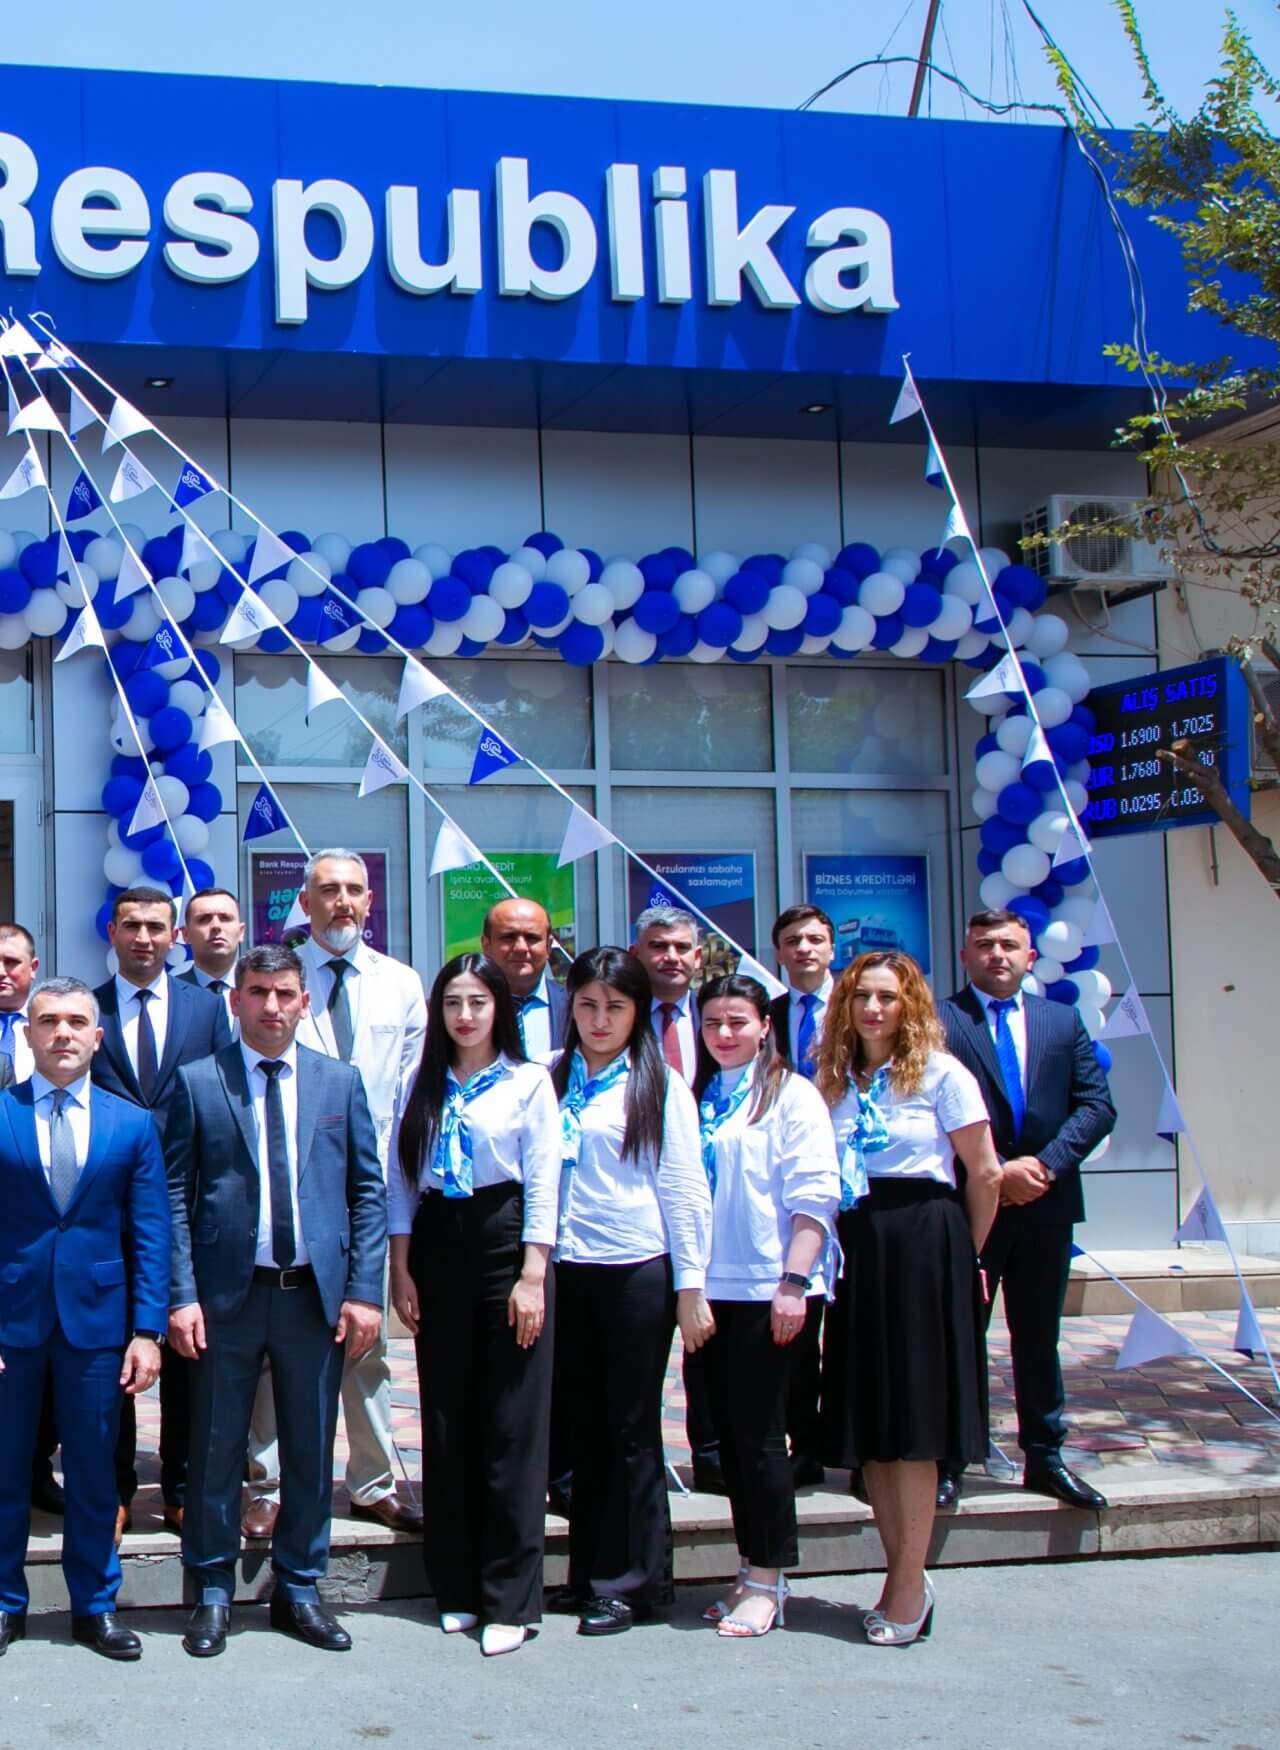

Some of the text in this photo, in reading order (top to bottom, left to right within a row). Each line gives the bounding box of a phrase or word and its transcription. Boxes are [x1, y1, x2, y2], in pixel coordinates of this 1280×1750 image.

[1164, 674, 1217, 703] SATIŞ
[1121, 725, 1161, 748] 1.6900
[1170, 713, 1215, 738] 1.7025
[1121, 759, 1161, 781] 1.7680
[1120, 793, 1161, 814] 0.0295
[259, 860, 279, 869] Bank
[708, 863, 743, 874] sabaha
[688, 877, 743, 887] saxlamayın!
[815, 872, 852, 885] BİZNES
